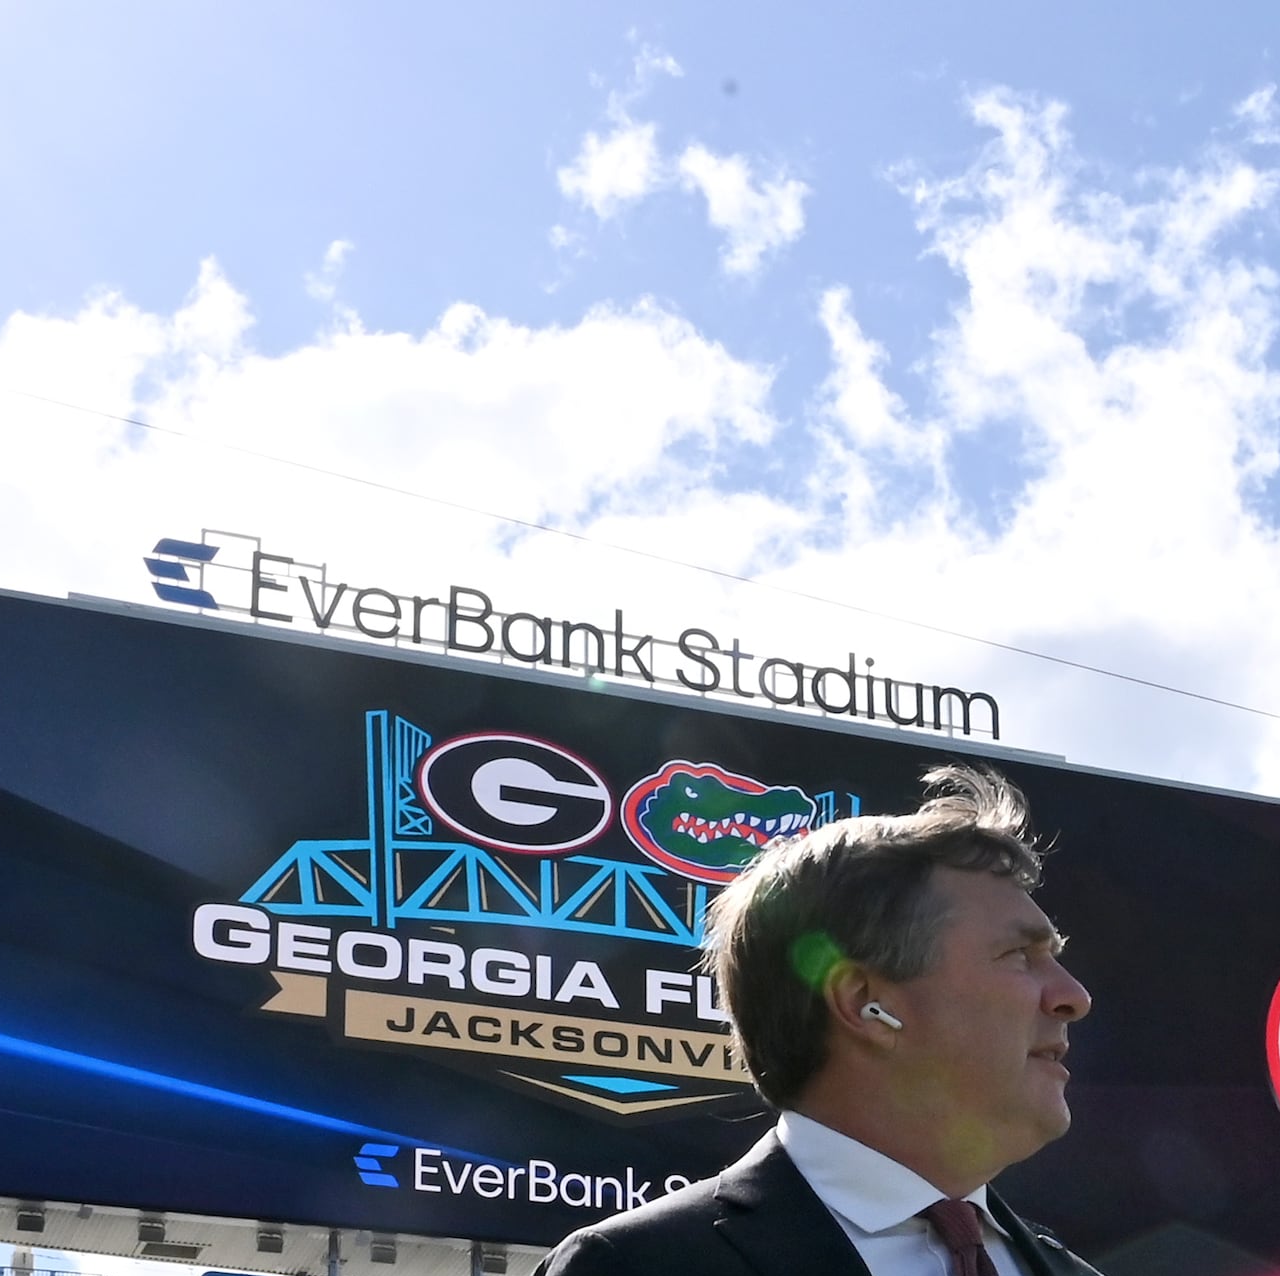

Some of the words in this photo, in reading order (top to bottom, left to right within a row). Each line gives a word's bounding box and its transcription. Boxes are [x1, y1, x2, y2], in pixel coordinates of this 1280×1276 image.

[250, 550, 655, 682] EverBank
[675, 627, 1000, 741] Stadium
[192, 902, 620, 1010] GEORGIA
[385, 1006, 748, 1073] JACKSONVI
[413, 1147, 652, 1212] EverBank
